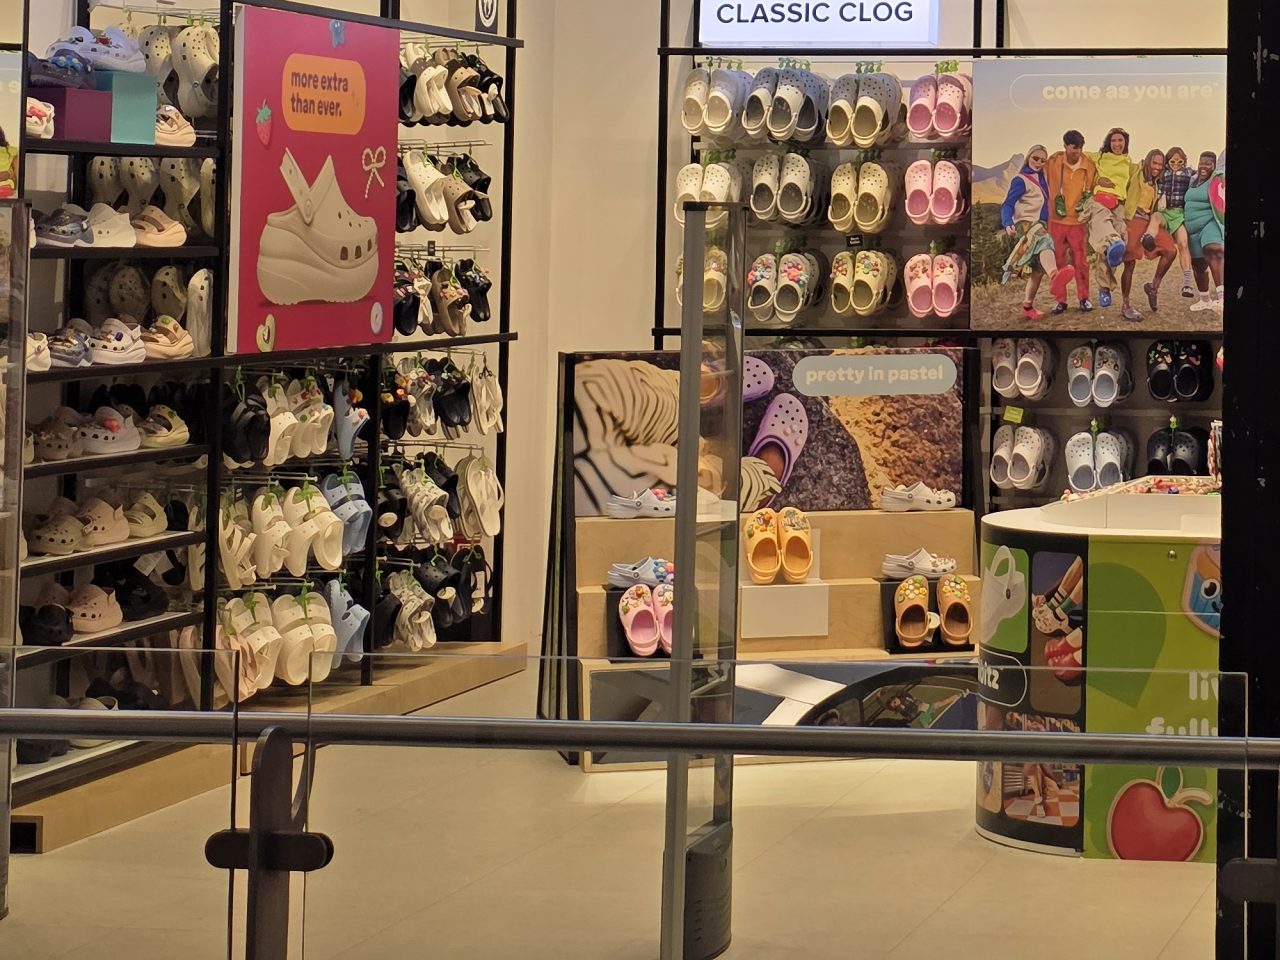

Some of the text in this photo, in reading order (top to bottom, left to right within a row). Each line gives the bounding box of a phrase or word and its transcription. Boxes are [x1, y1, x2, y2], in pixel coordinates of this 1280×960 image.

[716, 1, 913, 24] CLASSIC CLOG
[290, 71, 349, 93] more extra
[1042, 83, 1214, 103] come as you are
[290, 92, 342, 117] than ever.
[805, 364, 944, 385] pretty in pastel
